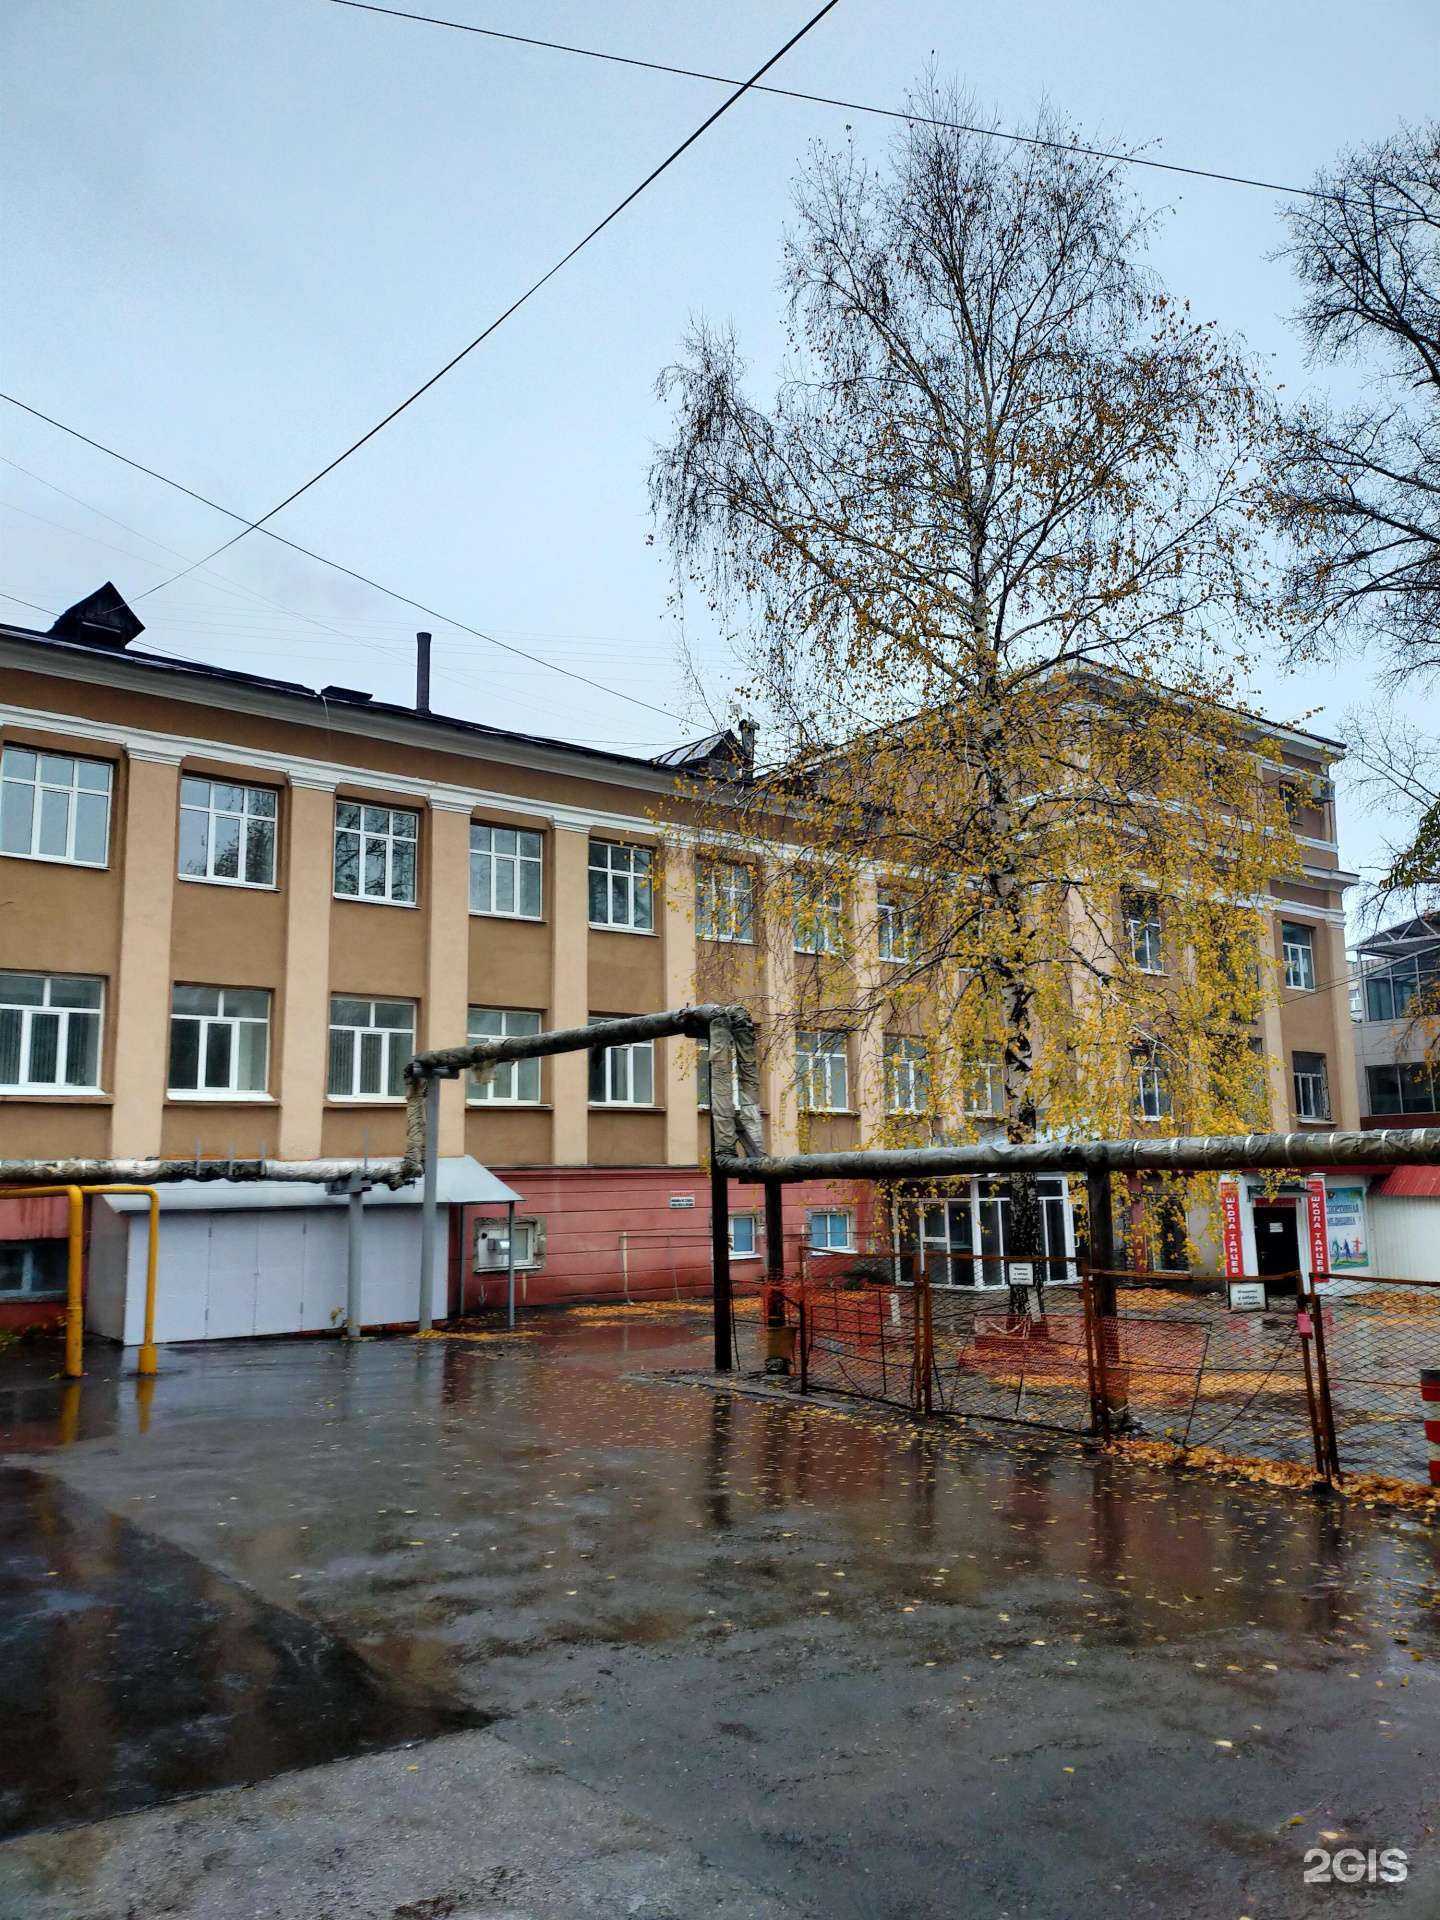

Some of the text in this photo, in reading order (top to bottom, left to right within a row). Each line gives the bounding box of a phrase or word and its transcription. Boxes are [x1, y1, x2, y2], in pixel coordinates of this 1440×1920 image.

[1225, 1197, 1239, 1274] ШКОЛА ТАНЦЕВ
[1311, 1196, 1324, 1272] ШКОЛА ТАНЦЕВ
